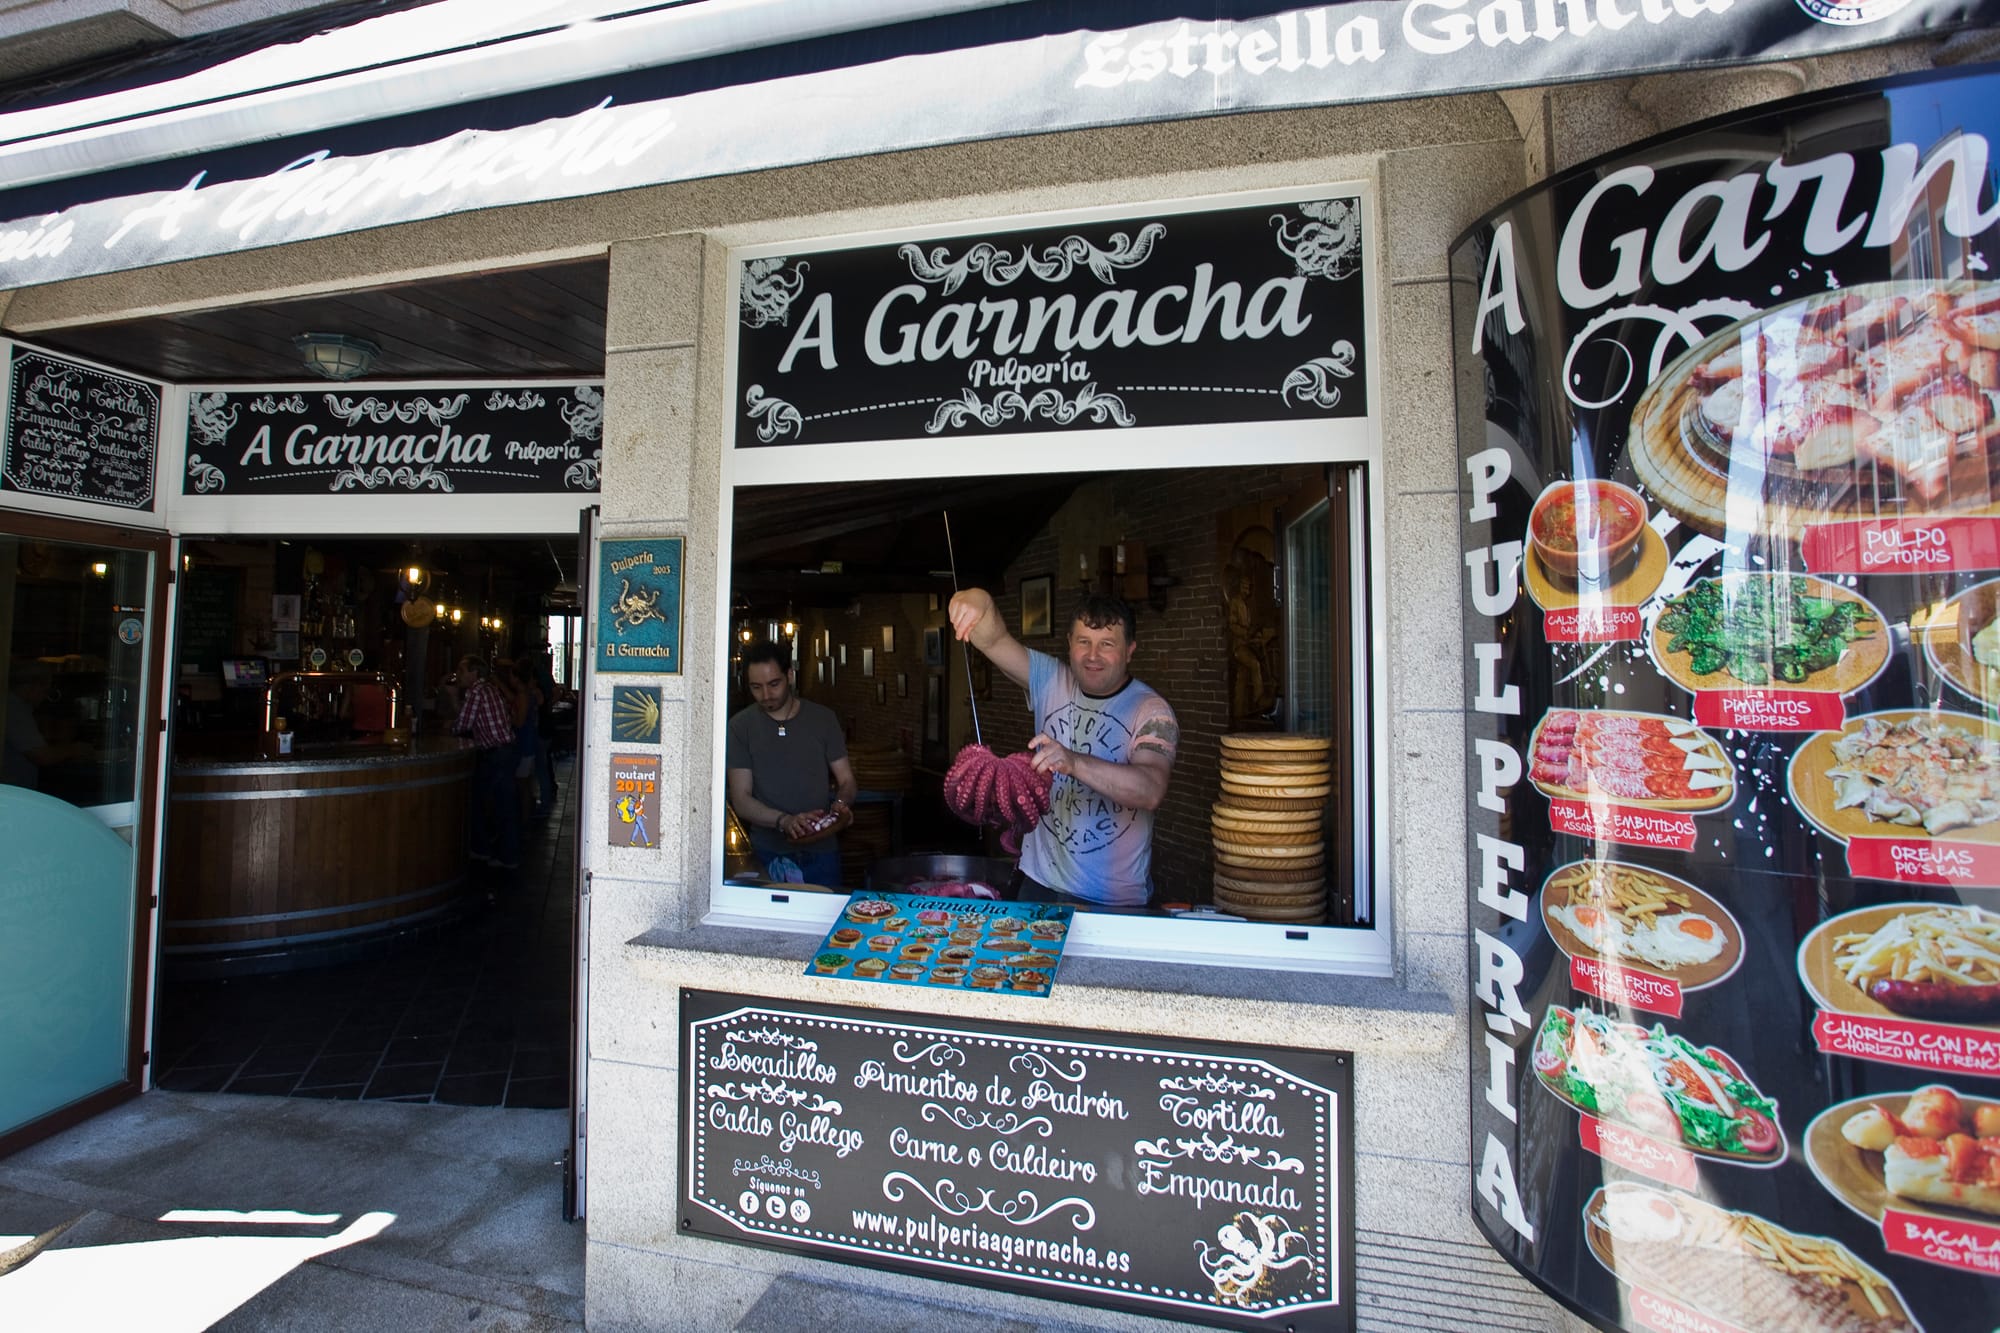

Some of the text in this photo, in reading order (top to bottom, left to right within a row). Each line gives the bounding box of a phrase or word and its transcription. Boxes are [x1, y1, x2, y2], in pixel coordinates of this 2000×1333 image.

[1074, 8, 1387, 88] Estrella
[1472, 134, 2000, 355] A Garn
[777, 262, 1312, 373] A Garnacha
[969, 356, 1089, 393] Pulpería
[30, 374, 81, 405] Pulpo
[90, 388, 146, 417] Tortilla
[16, 406, 82, 434] Empanada
[100, 423, 129, 442] Carne
[20, 435, 91, 462] Caldo Gallego
[240, 425, 582, 467] A Garnacha Pulpería
[33, 465, 72, 488] Orejas
[1866, 528, 1946, 549] PULPO
[1863, 548, 1951, 565] OCTOPUS
[1722, 698, 1812, 714] PIMIENTOS
[1734, 714, 1800, 726] PEPPERS
[615, 770, 656, 780] routard
[616, 780, 655, 793] 2012
[1552, 806, 1592, 823] TABLA
[1614, 815, 1696, 835] EMBUTIDOS
[1614, 828, 1645, 841] COLD
[1646, 833, 1681, 846] MEAT
[1891, 845, 1974, 864] OREJAS
[1894, 861, 1975, 879] PIG'S EAR
[907, 897, 1010, 916] Garnacha
[1576, 959, 1675, 998] HUEVOS FRITOS
[1624, 989, 1654, 1004] EGGS
[1822, 1020, 1915, 1047] CHORIZO
[1919, 1033, 1960, 1053] CON
[710, 1042, 837, 1084] Bocadillos
[1833, 1037, 2000, 1070] CHORIZO WITH FRENC
[854, 1060, 1129, 1120] Pimientos de Padrón
[709, 1101, 864, 1159] Caldo Gallego
[1159, 1093, 1284, 1138] Tortilla
[889, 1127, 1098, 1184] Carne o Caldeiro
[794, 1187, 805, 1198] en
[1138, 1159, 1301, 1210] Empanada
[852, 1209, 1131, 1273] www.pulperiaagarnacha.es
[1923, 1244, 1961, 1262] COD
